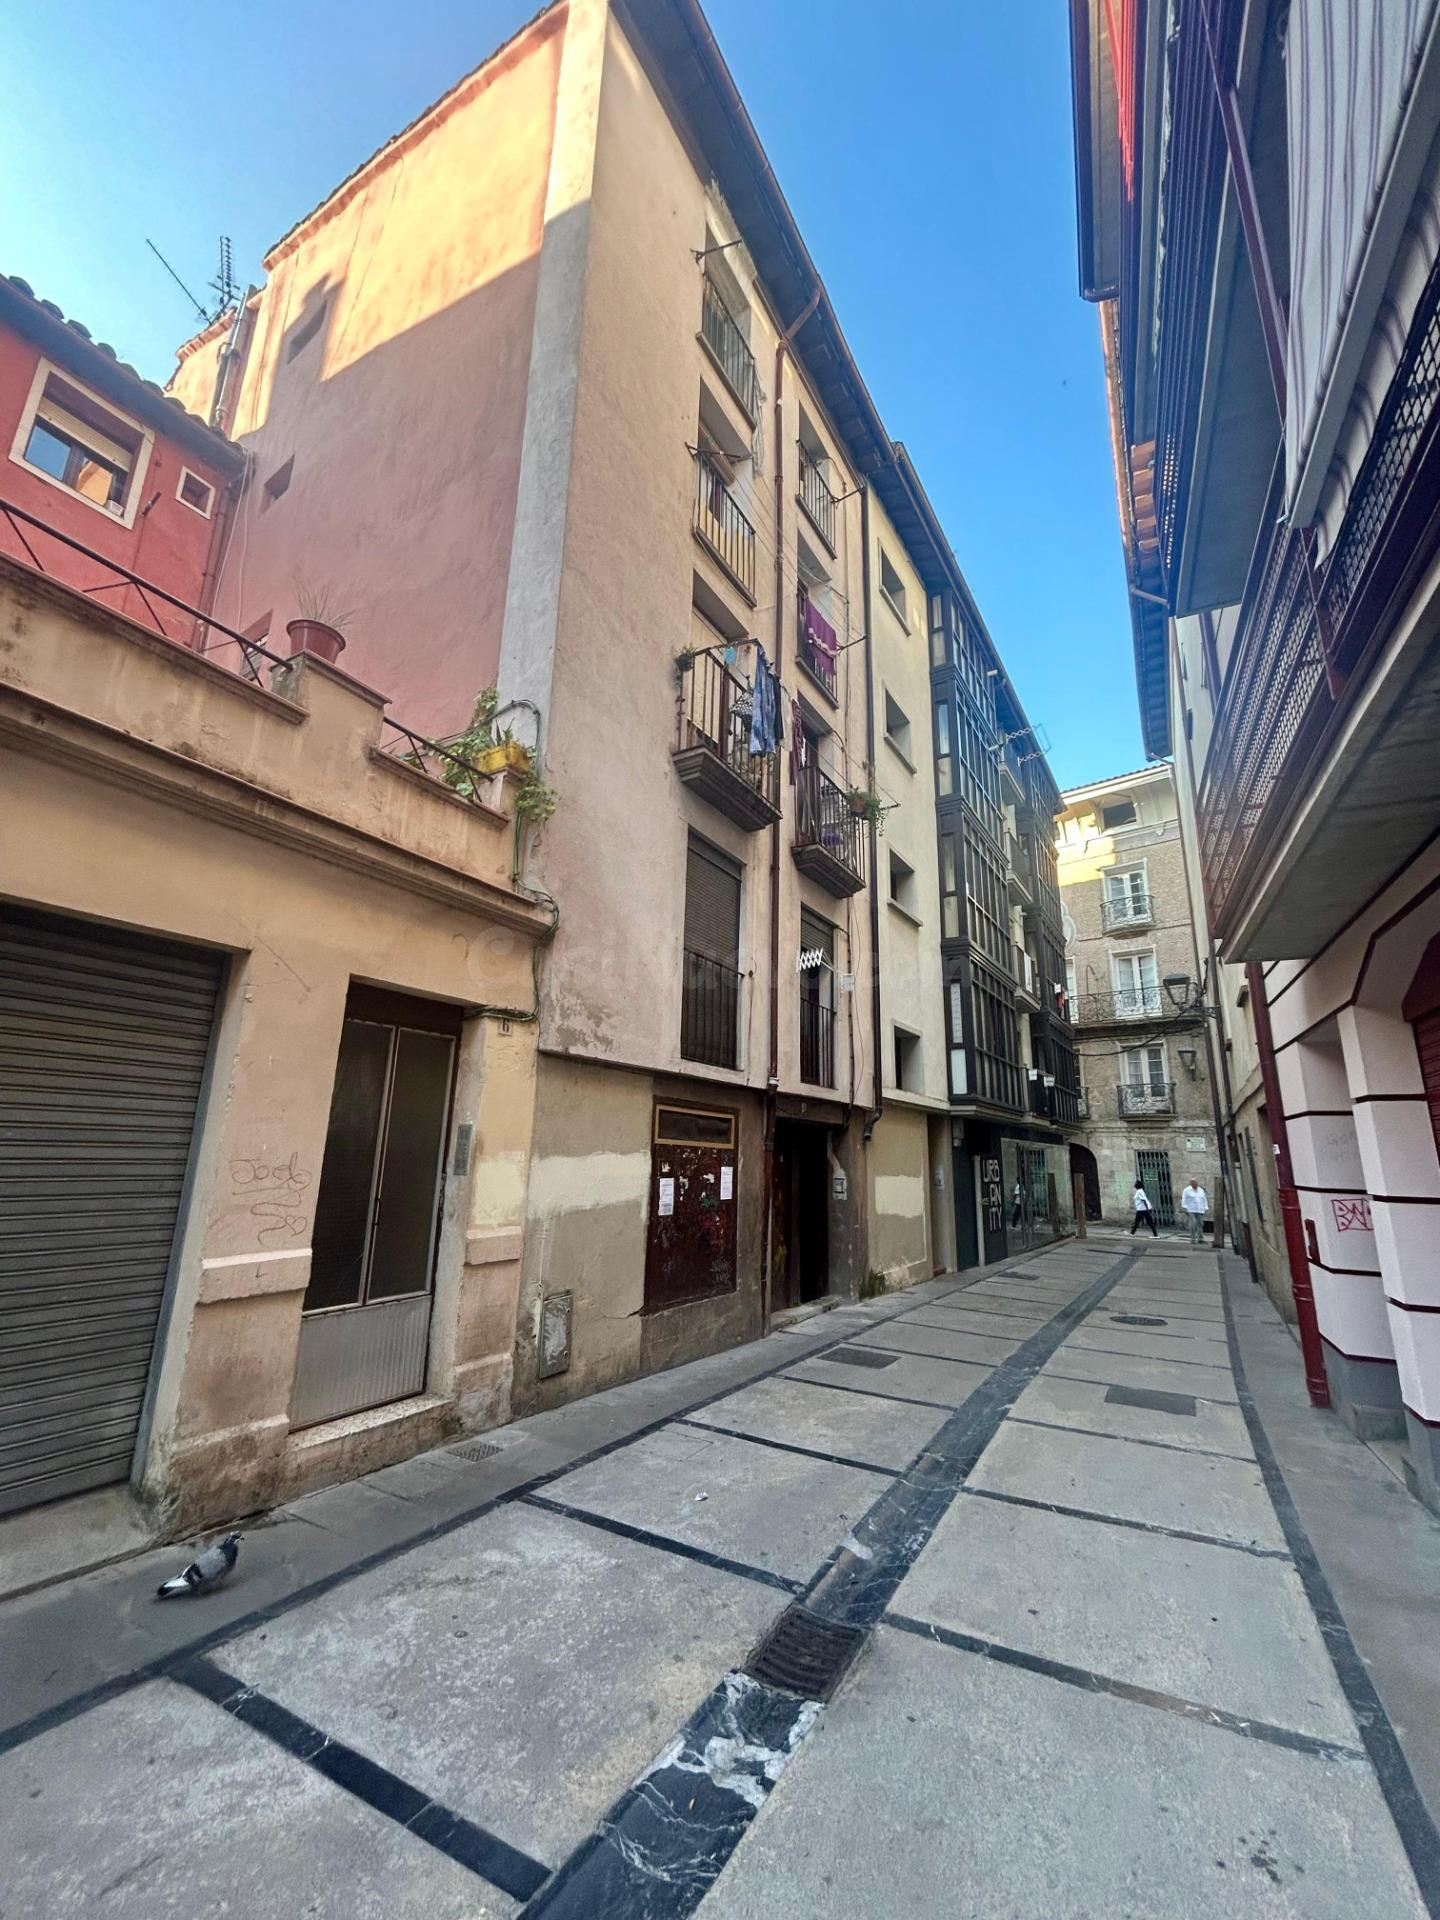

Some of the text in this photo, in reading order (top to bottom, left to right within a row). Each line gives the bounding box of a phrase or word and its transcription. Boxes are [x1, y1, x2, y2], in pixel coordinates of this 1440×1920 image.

[983, 1159, 1000, 1182] URB
[989, 1183, 1001, 1206] AN
[989, 1206, 1002, 1231] ITY
